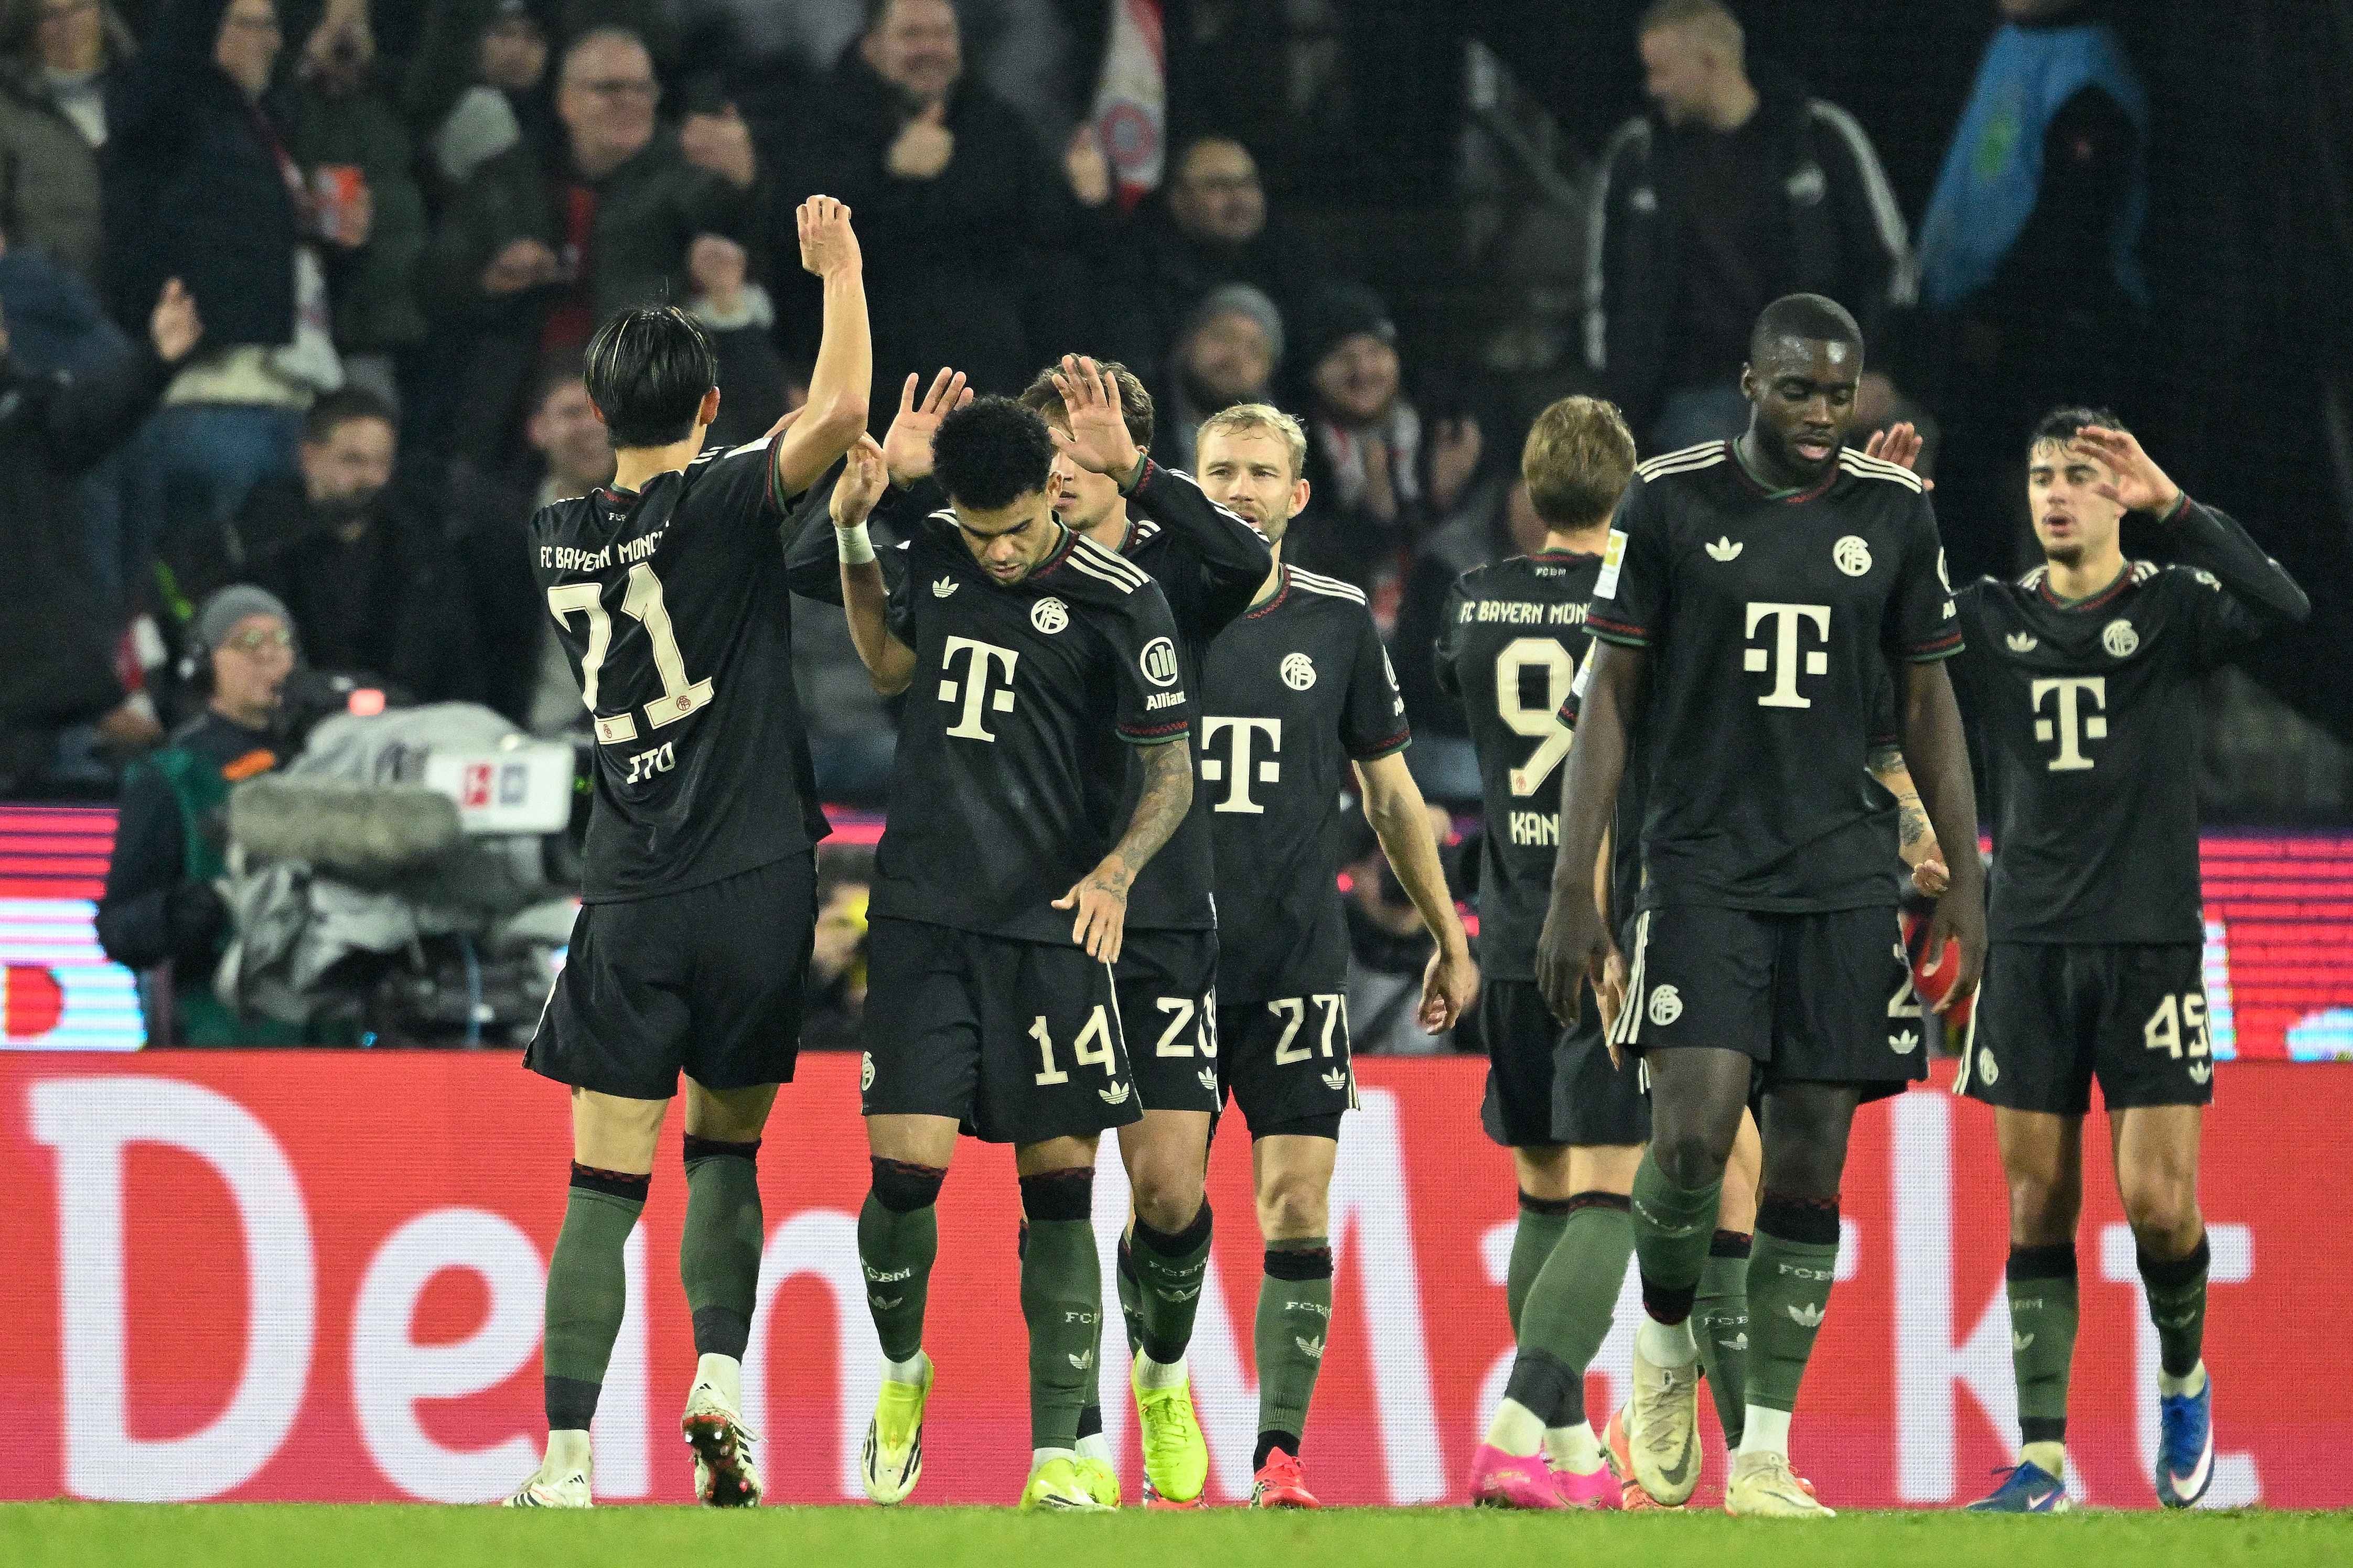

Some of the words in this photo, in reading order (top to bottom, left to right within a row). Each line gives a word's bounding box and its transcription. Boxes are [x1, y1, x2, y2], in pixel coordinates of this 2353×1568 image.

[541, 546, 553, 568] FC
[1460, 601, 1476, 623] FC
[1478, 600, 1544, 624] BAYERN
[1550, 602, 1591, 624] MÜN
[939, 635, 1019, 742] T
[1744, 602, 1831, 708] T
[1146, 691, 1186, 711] Allian
[1498, 638, 1573, 796] 9
[2032, 676, 2107, 770] T
[627, 742, 675, 784] ITO
[1202, 716, 1281, 814] T
[1028, 1004, 1116, 1085] 14
[1268, 994, 1339, 1065] 27
[2145, 992, 2209, 1058] 45
